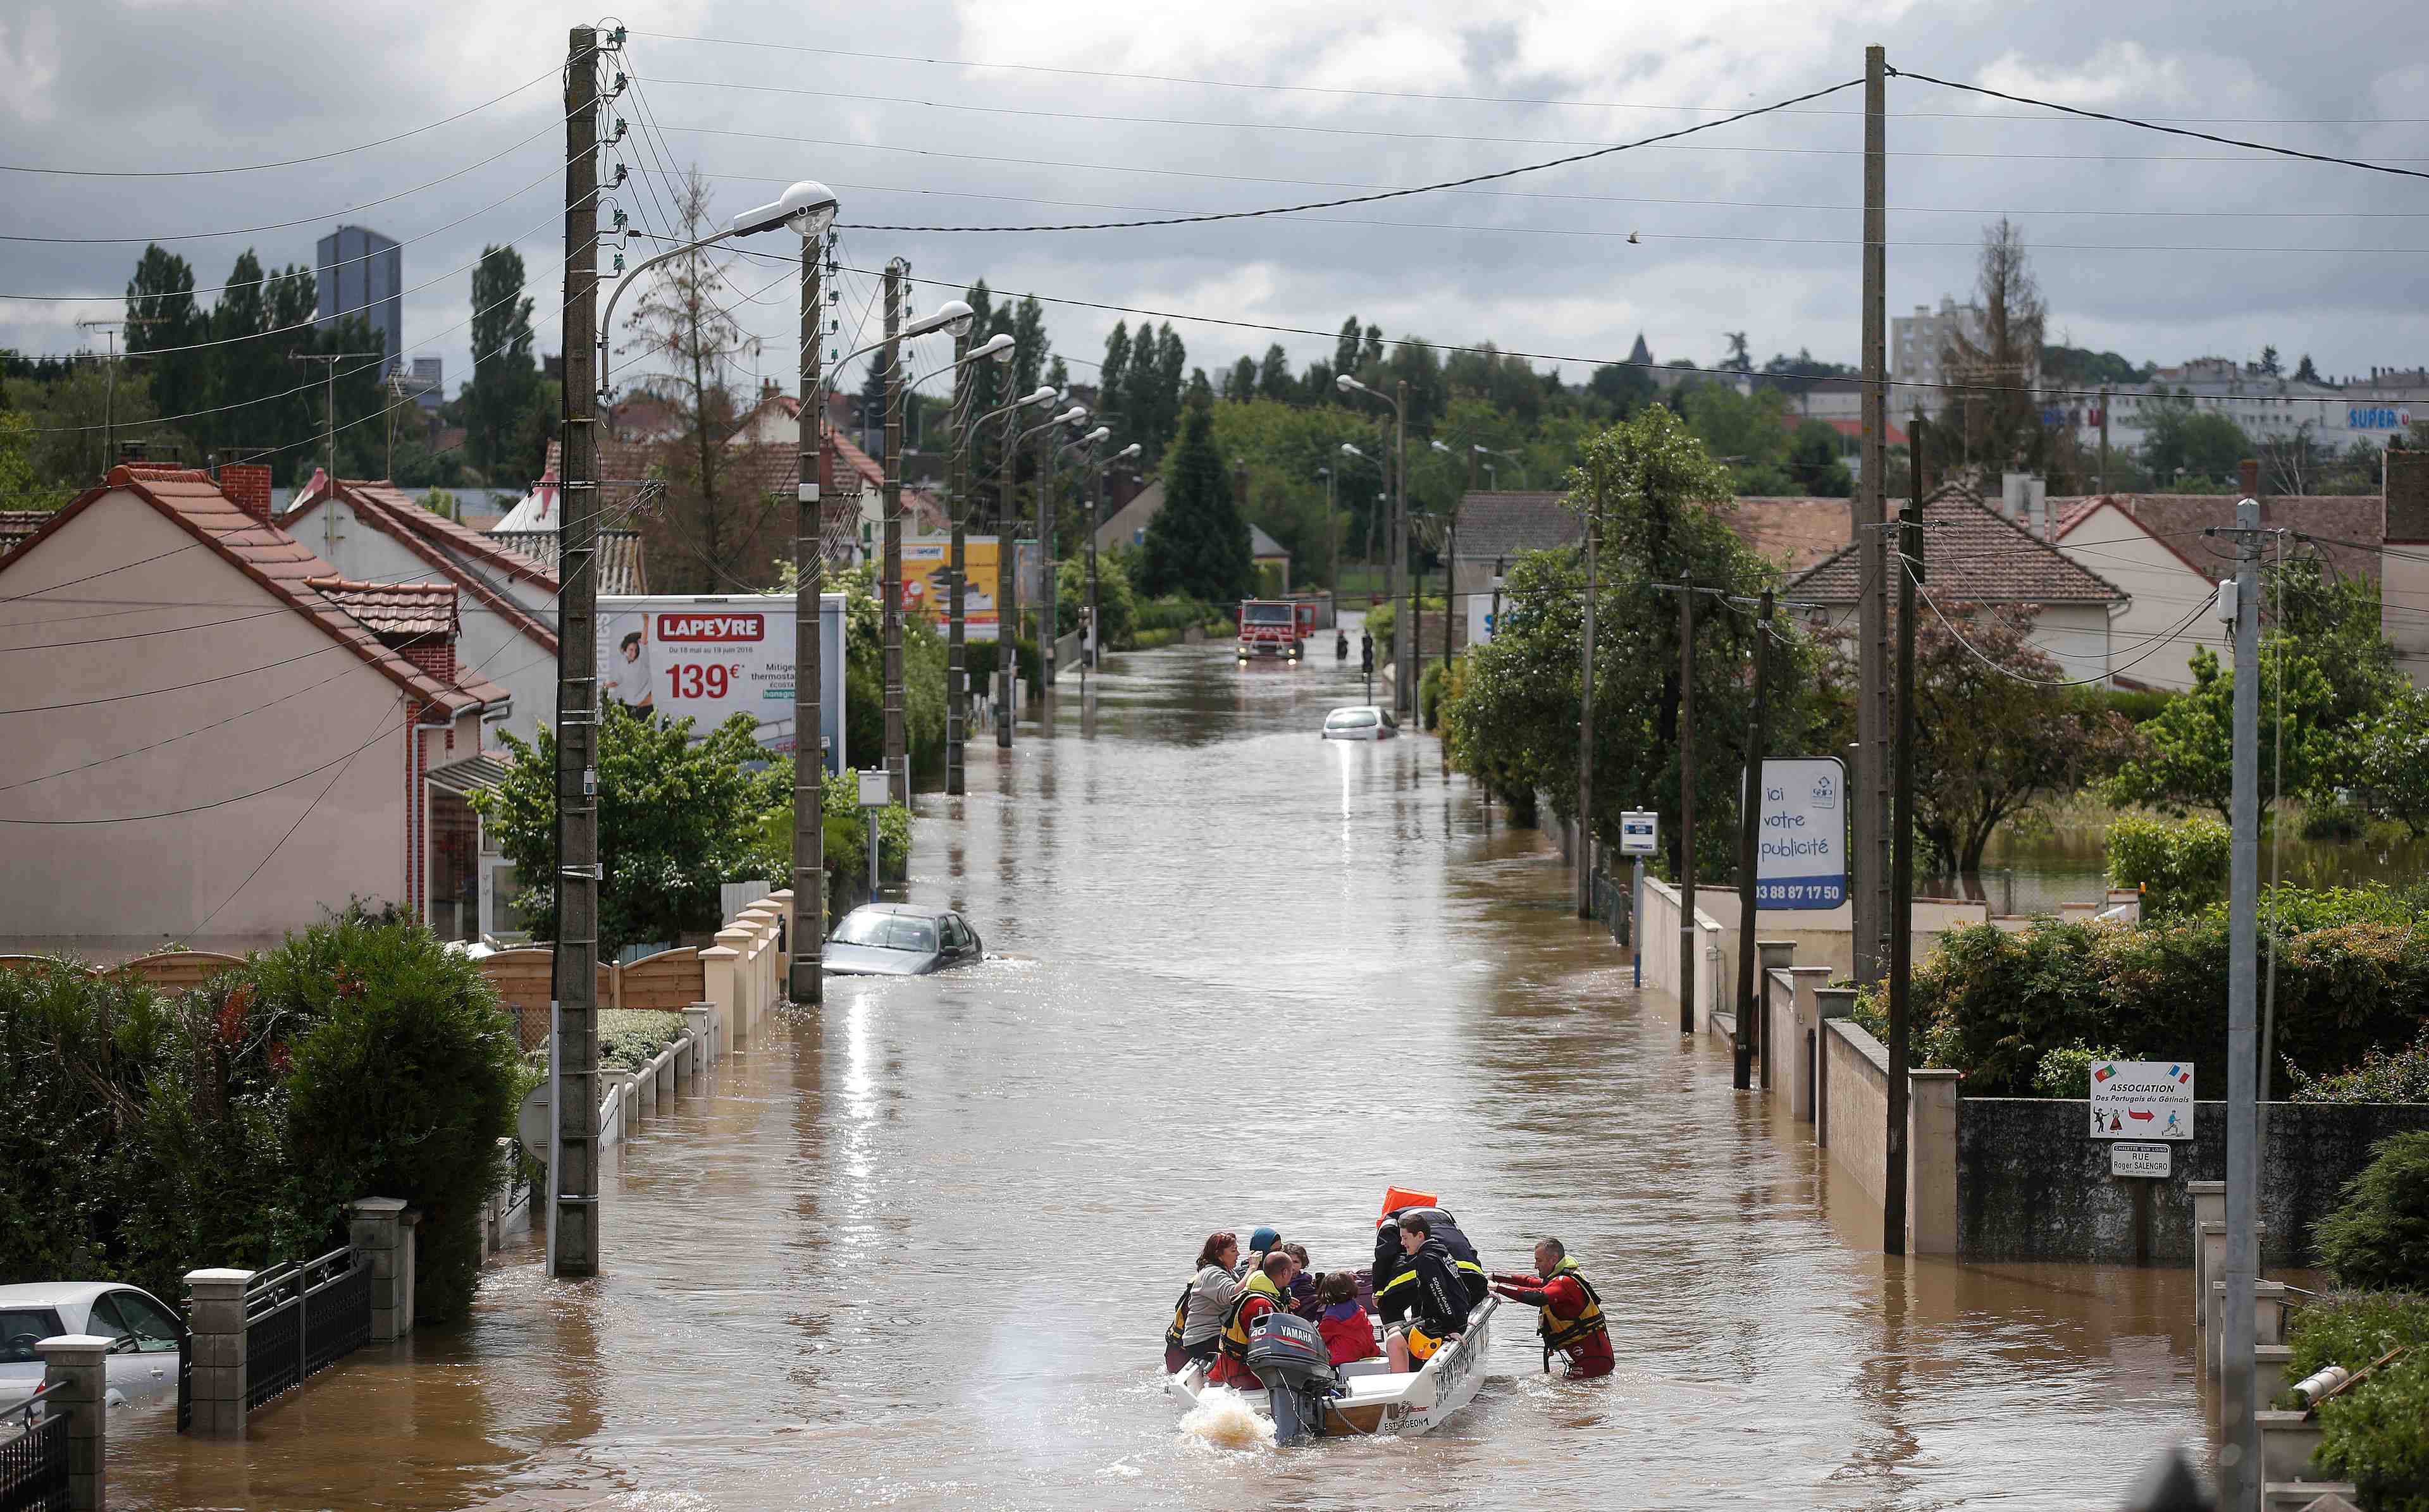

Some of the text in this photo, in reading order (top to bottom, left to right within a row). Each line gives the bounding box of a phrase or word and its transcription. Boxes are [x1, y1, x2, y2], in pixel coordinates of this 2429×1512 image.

[2349, 408, 2399, 427] SUPER
[664, 618, 758, 637] LAPEYRE
[723, 646, 735, 655] juin
[751, 672, 795, 681] thermosta
[1767, 788, 1784, 801] ici
[1764, 810, 1805, 828] votre
[1761, 838, 1829, 862] publicité
[1770, 886, 1785, 899] 88
[1788, 886, 1803, 899] 87
[1807, 885, 1822, 899] 17
[1824, 885, 1839, 899] 50
[2110, 1084, 2175, 1093] ASSOCIATION
[2114, 1161, 2167, 1170] Roger SALENGRO
[1251, 1328, 1266, 1337] 40
[1280, 1325, 1313, 1344] YAMAHA
